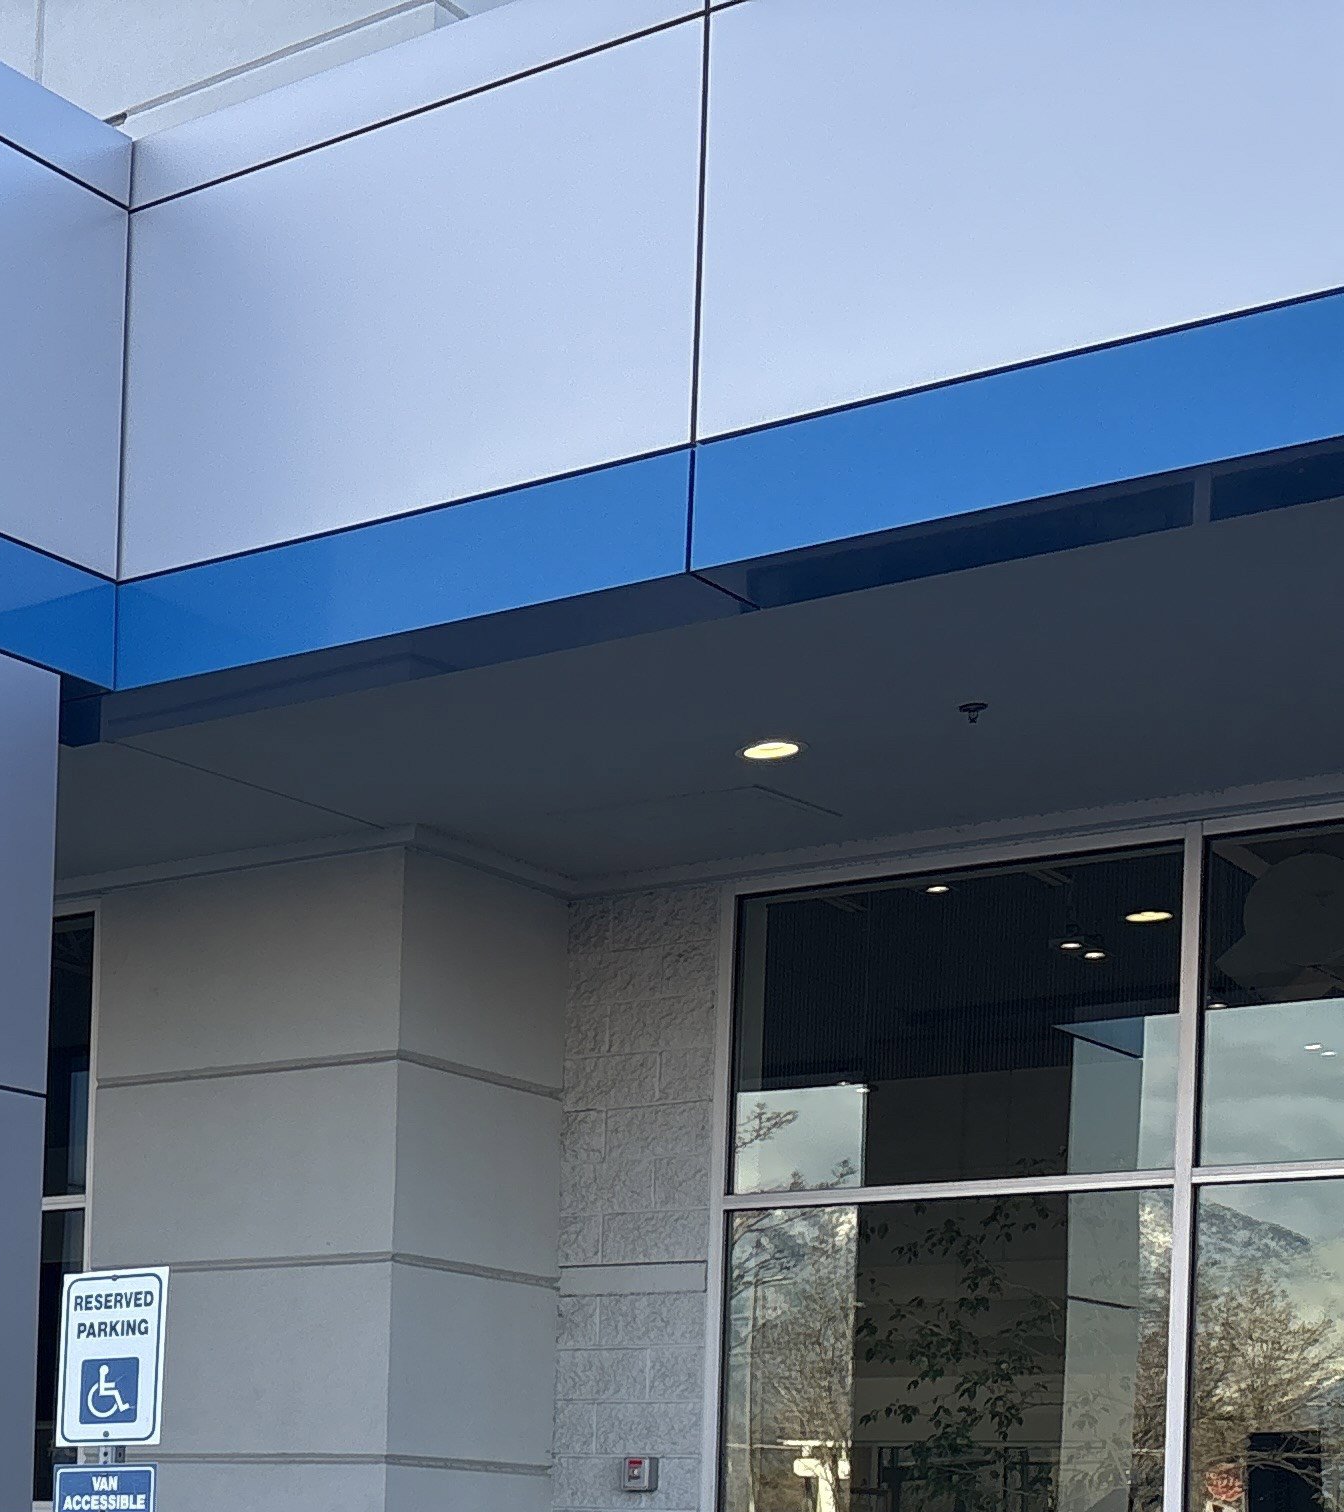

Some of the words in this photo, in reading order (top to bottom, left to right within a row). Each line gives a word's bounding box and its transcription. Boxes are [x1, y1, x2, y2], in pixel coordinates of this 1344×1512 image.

[73, 1289, 155, 1312] RESERVED
[76, 1318, 150, 1340] PARKING
[91, 1475, 119, 1492] VAN
[62, 1493, 147, 1512] ACCESSIBLE
